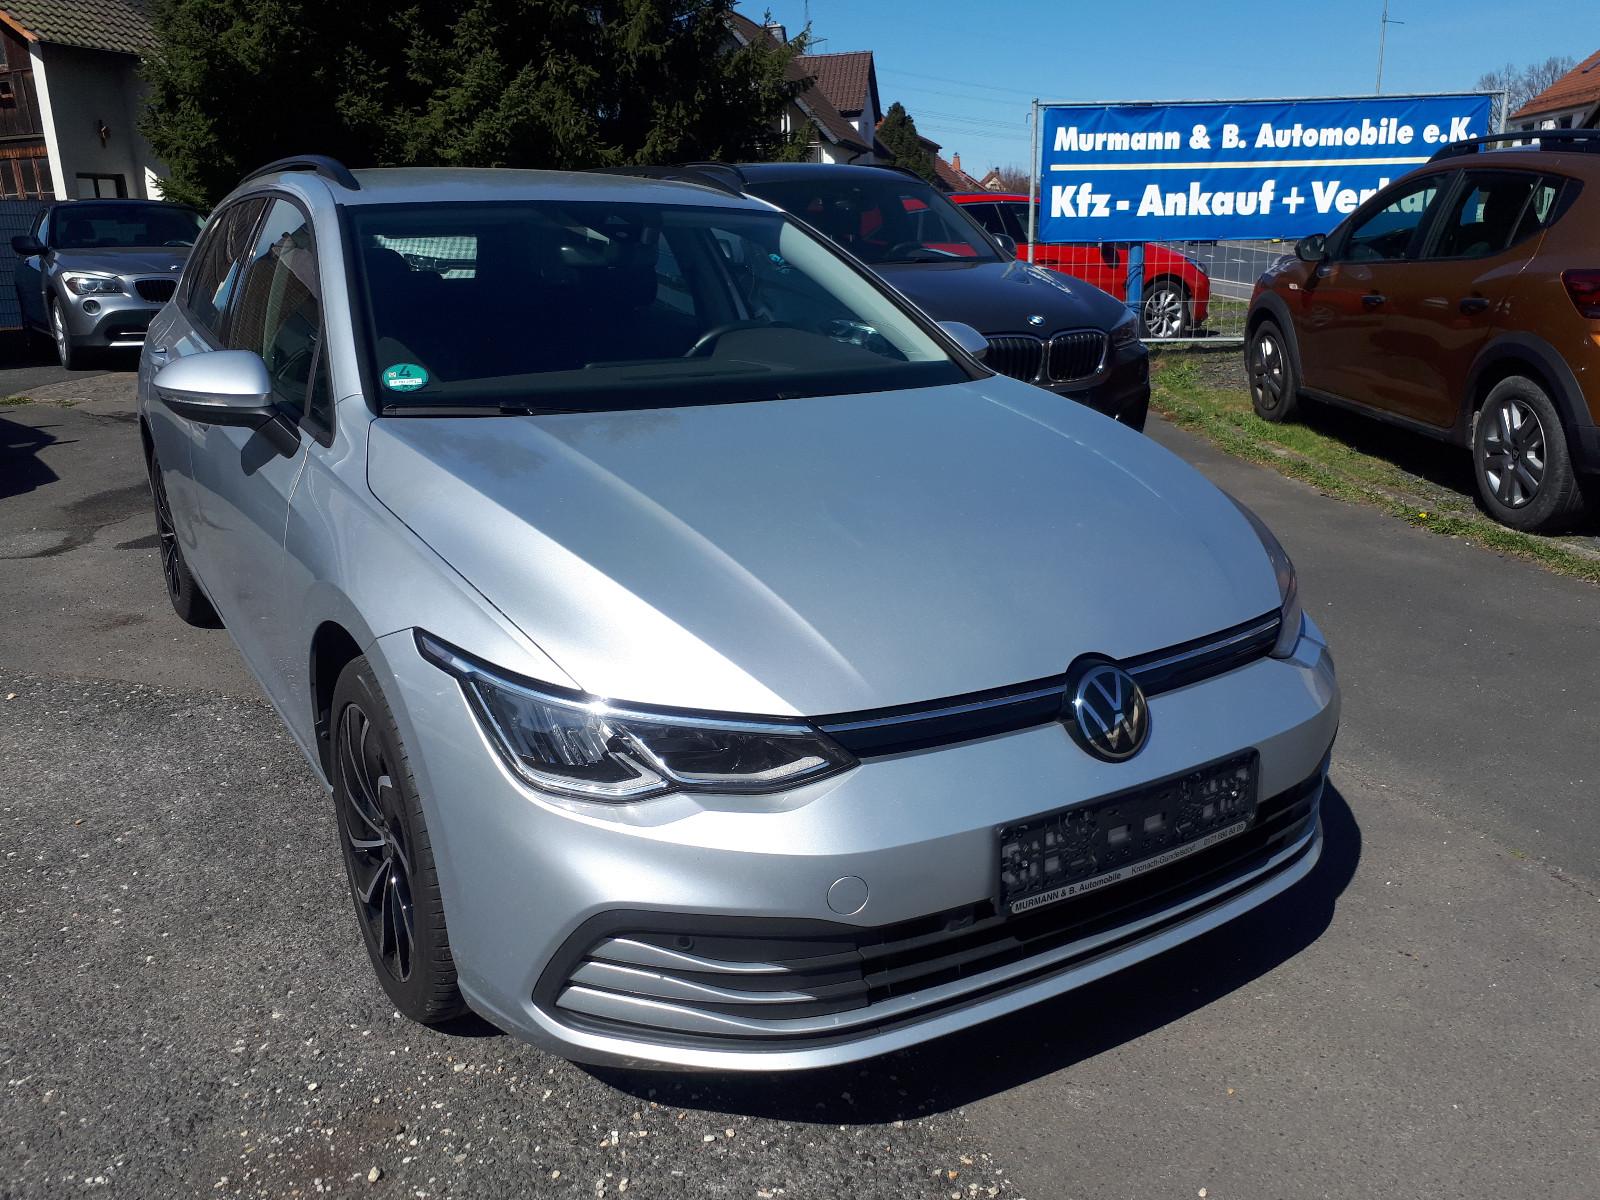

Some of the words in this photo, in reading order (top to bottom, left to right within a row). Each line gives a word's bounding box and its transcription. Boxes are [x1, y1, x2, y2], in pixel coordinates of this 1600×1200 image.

[1054, 126, 1181, 151] Murmann
[1189, 125, 1211, 149] &
[1222, 124, 1246, 149] B.
[1254, 117, 1414, 148] Automobile
[1422, 116, 1478, 143] e.K.
[1051, 183, 1111, 217] Kfz
[1136, 180, 1276, 217] Ankauf
[1282, 186, 1305, 214] +
[397, 365, 412, 377] 4
[1014, 891, 1060, 912] MURMANN
[1079, 872, 1122, 891] Automobile
